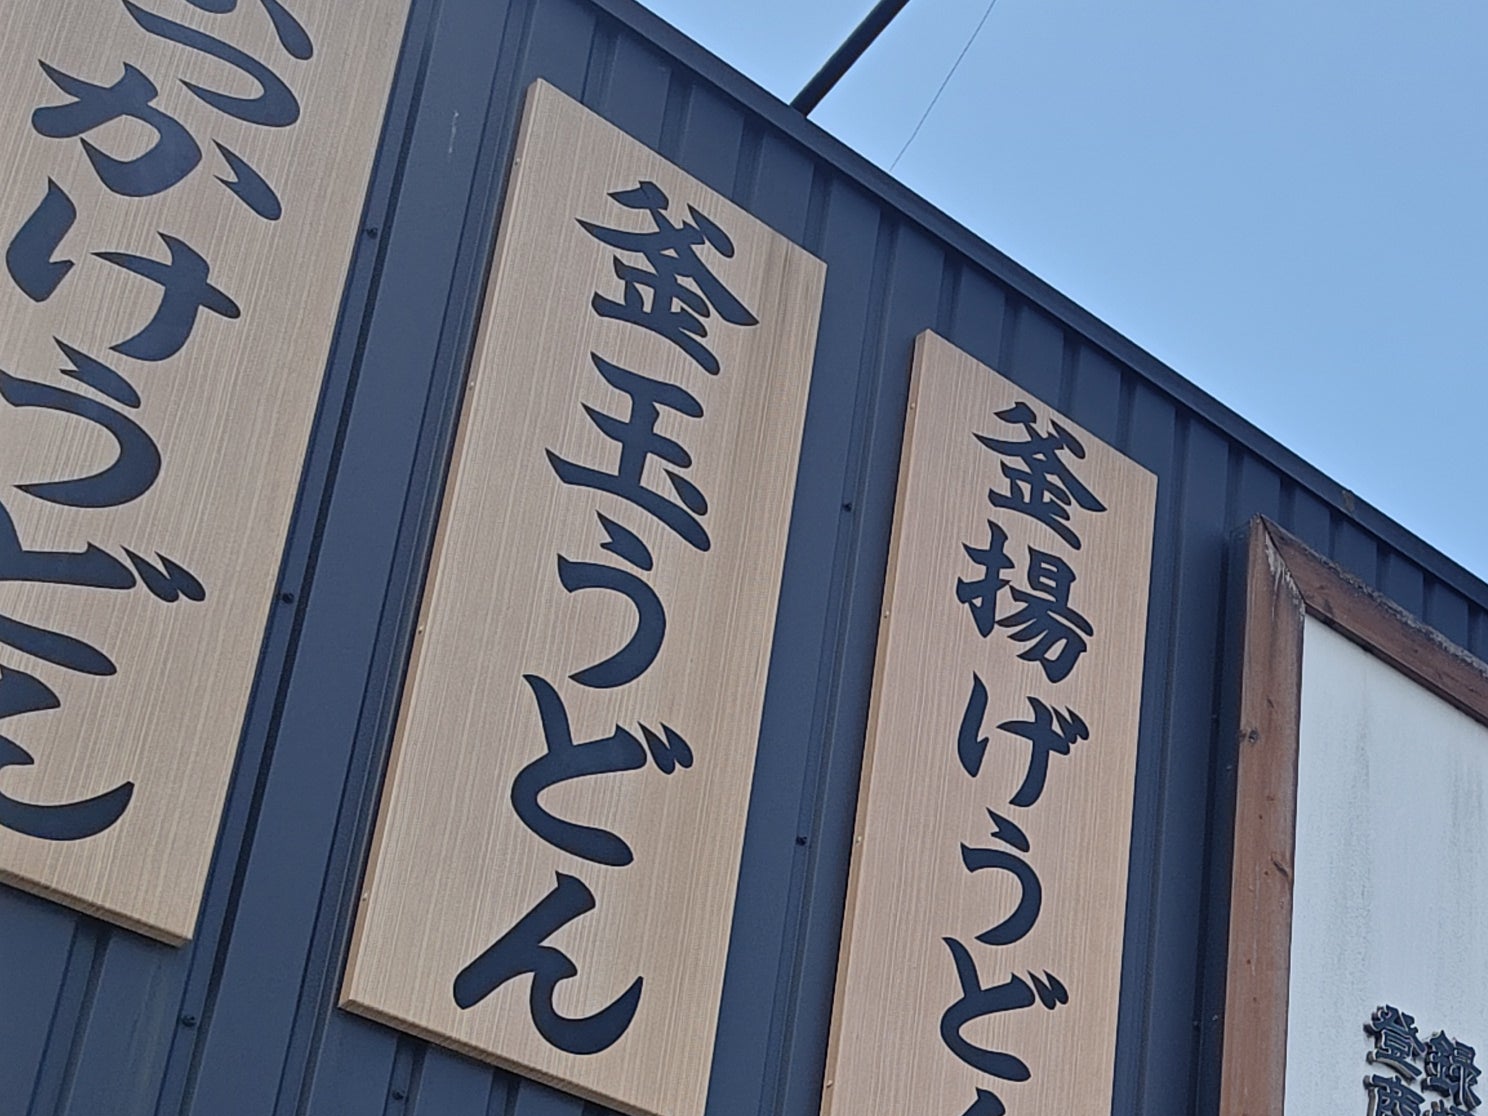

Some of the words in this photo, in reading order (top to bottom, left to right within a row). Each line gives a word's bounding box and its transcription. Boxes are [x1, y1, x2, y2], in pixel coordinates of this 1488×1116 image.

[453, 179, 760, 1056] 釜玉うどん
[1363, 1003, 1482, 1111] 登録
